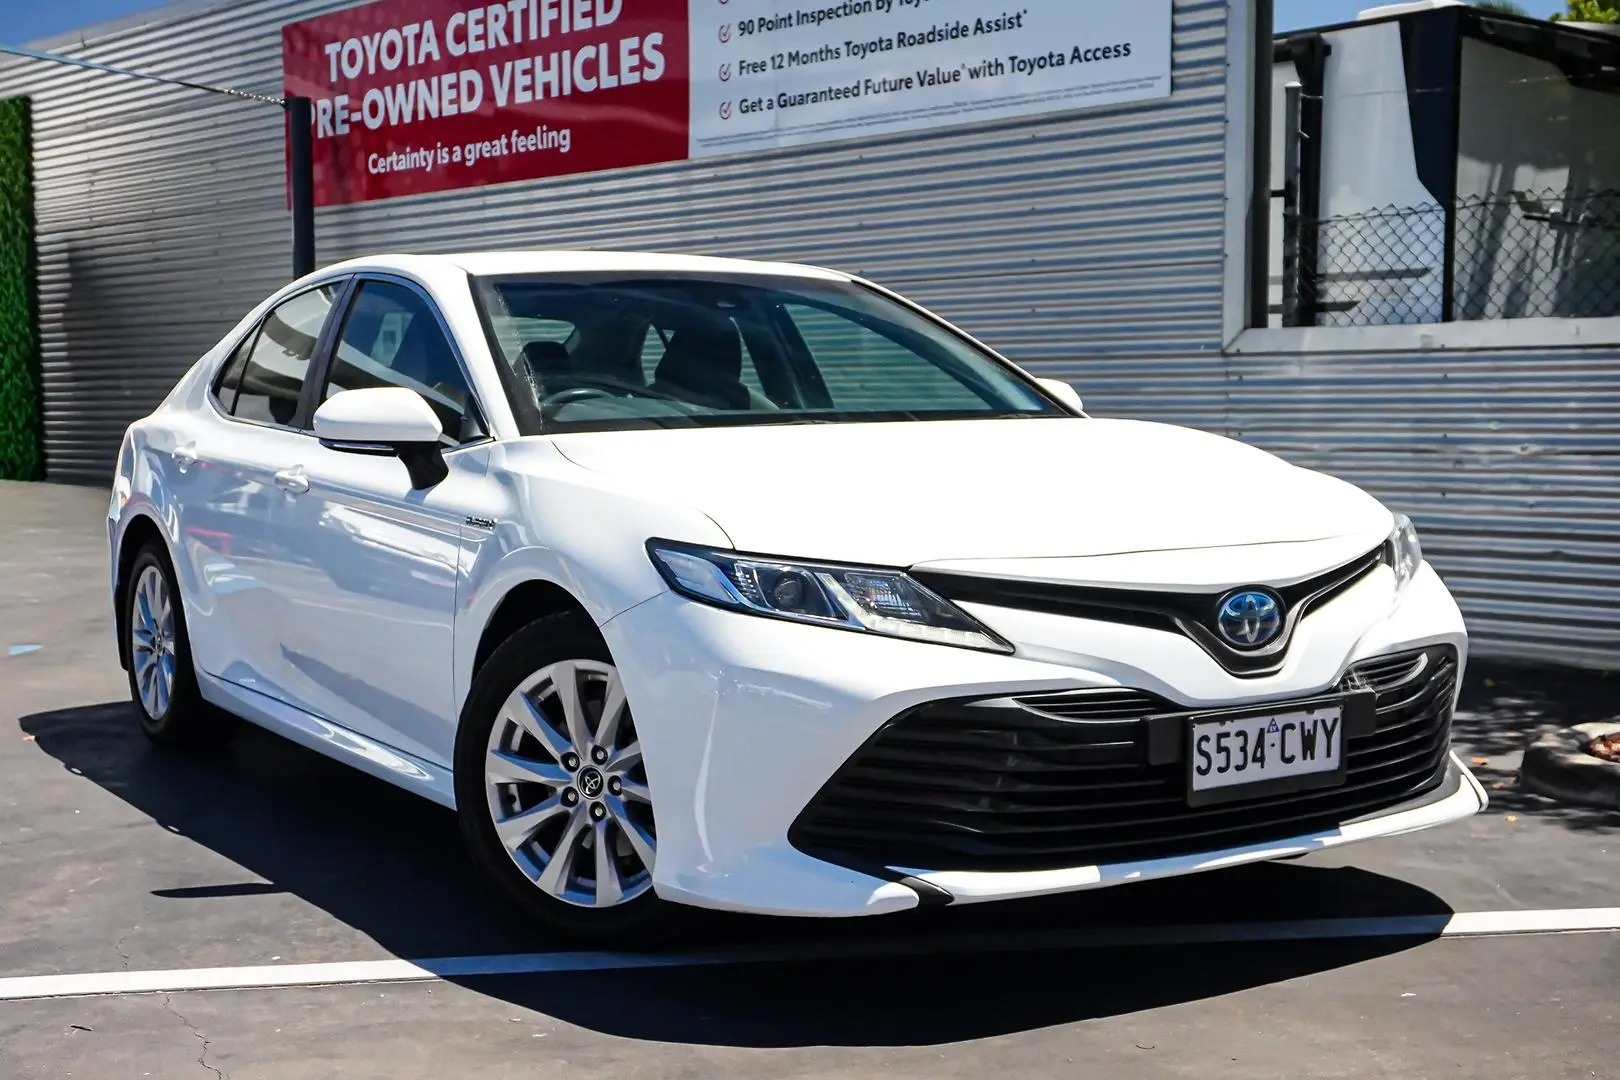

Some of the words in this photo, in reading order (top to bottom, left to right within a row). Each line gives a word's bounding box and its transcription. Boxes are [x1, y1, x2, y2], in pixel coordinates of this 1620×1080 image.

[324, 19, 441, 83] TOYOTA
[445, 0, 624, 57] CERTIFIED
[738, 19, 755, 37] 90
[757, 13, 793, 33] Point
[796, 0, 872, 27] Inspection
[875, 0, 894, 13] by
[738, 59, 767, 76] Free
[770, 54, 784, 71] 12
[787, 44, 841, 68] Months
[844, 36, 894, 60] Toyota
[897, 20, 969, 49] Roadside
[311, 68, 484, 140] RE-OWNED
[488, 32, 666, 108] VEHICLES
[739, 98, 763, 115] Get
[766, 98, 774, 110] a
[777, 80, 861, 109] Guaranteed
[864, 76, 913, 96] Future
[968, 57, 1004, 80] with
[1008, 50, 1065, 76] Toyota
[1069, 42, 1132, 65] Access
[368, 146, 435, 174] Certainty
[437, 142, 449, 165] is
[452, 145, 462, 162] a
[464, 134, 508, 167] great
[511, 125, 571, 153] feeling
